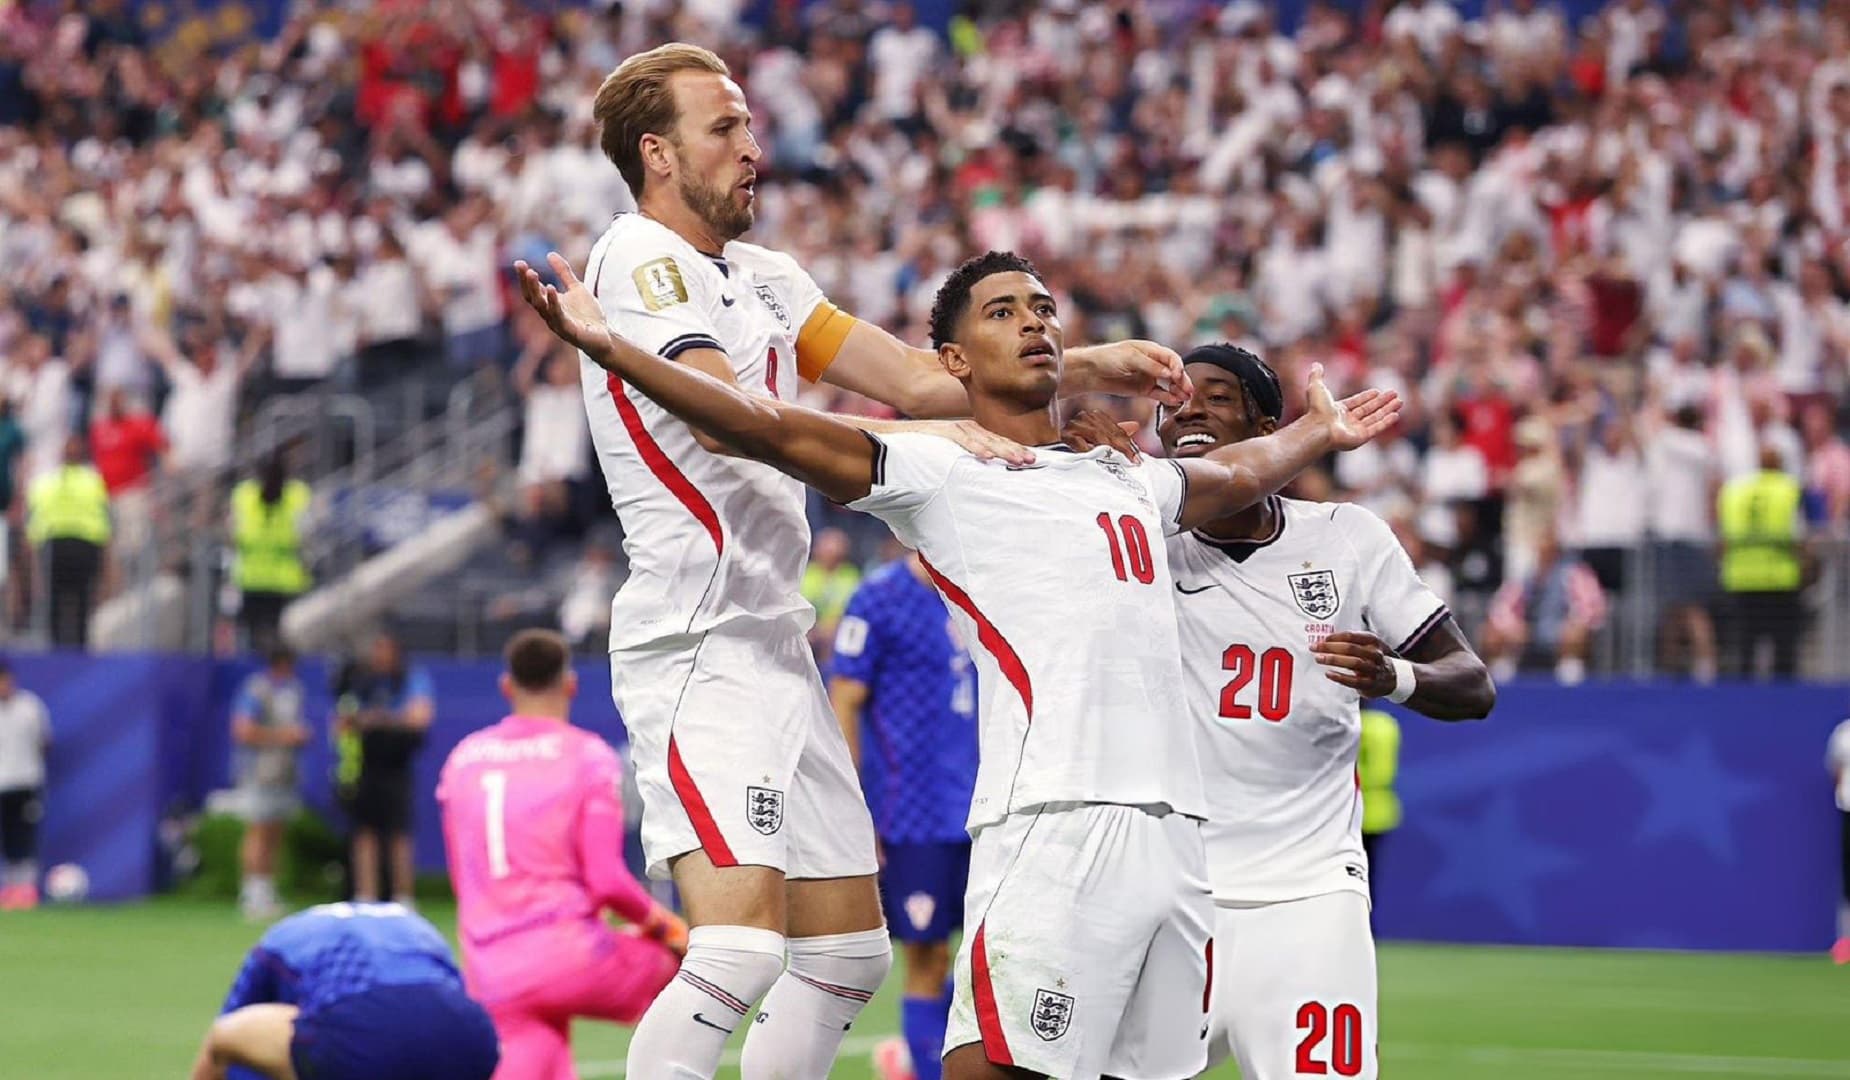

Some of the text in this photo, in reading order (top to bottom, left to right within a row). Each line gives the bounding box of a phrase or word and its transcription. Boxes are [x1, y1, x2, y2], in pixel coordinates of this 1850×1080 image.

[1096, 511, 1155, 584] 10
[1304, 623, 1335, 633] CROATIA
[1218, 643, 1294, 722] 20
[481, 770, 510, 880] 1
[1295, 1000, 1362, 1077] 20
